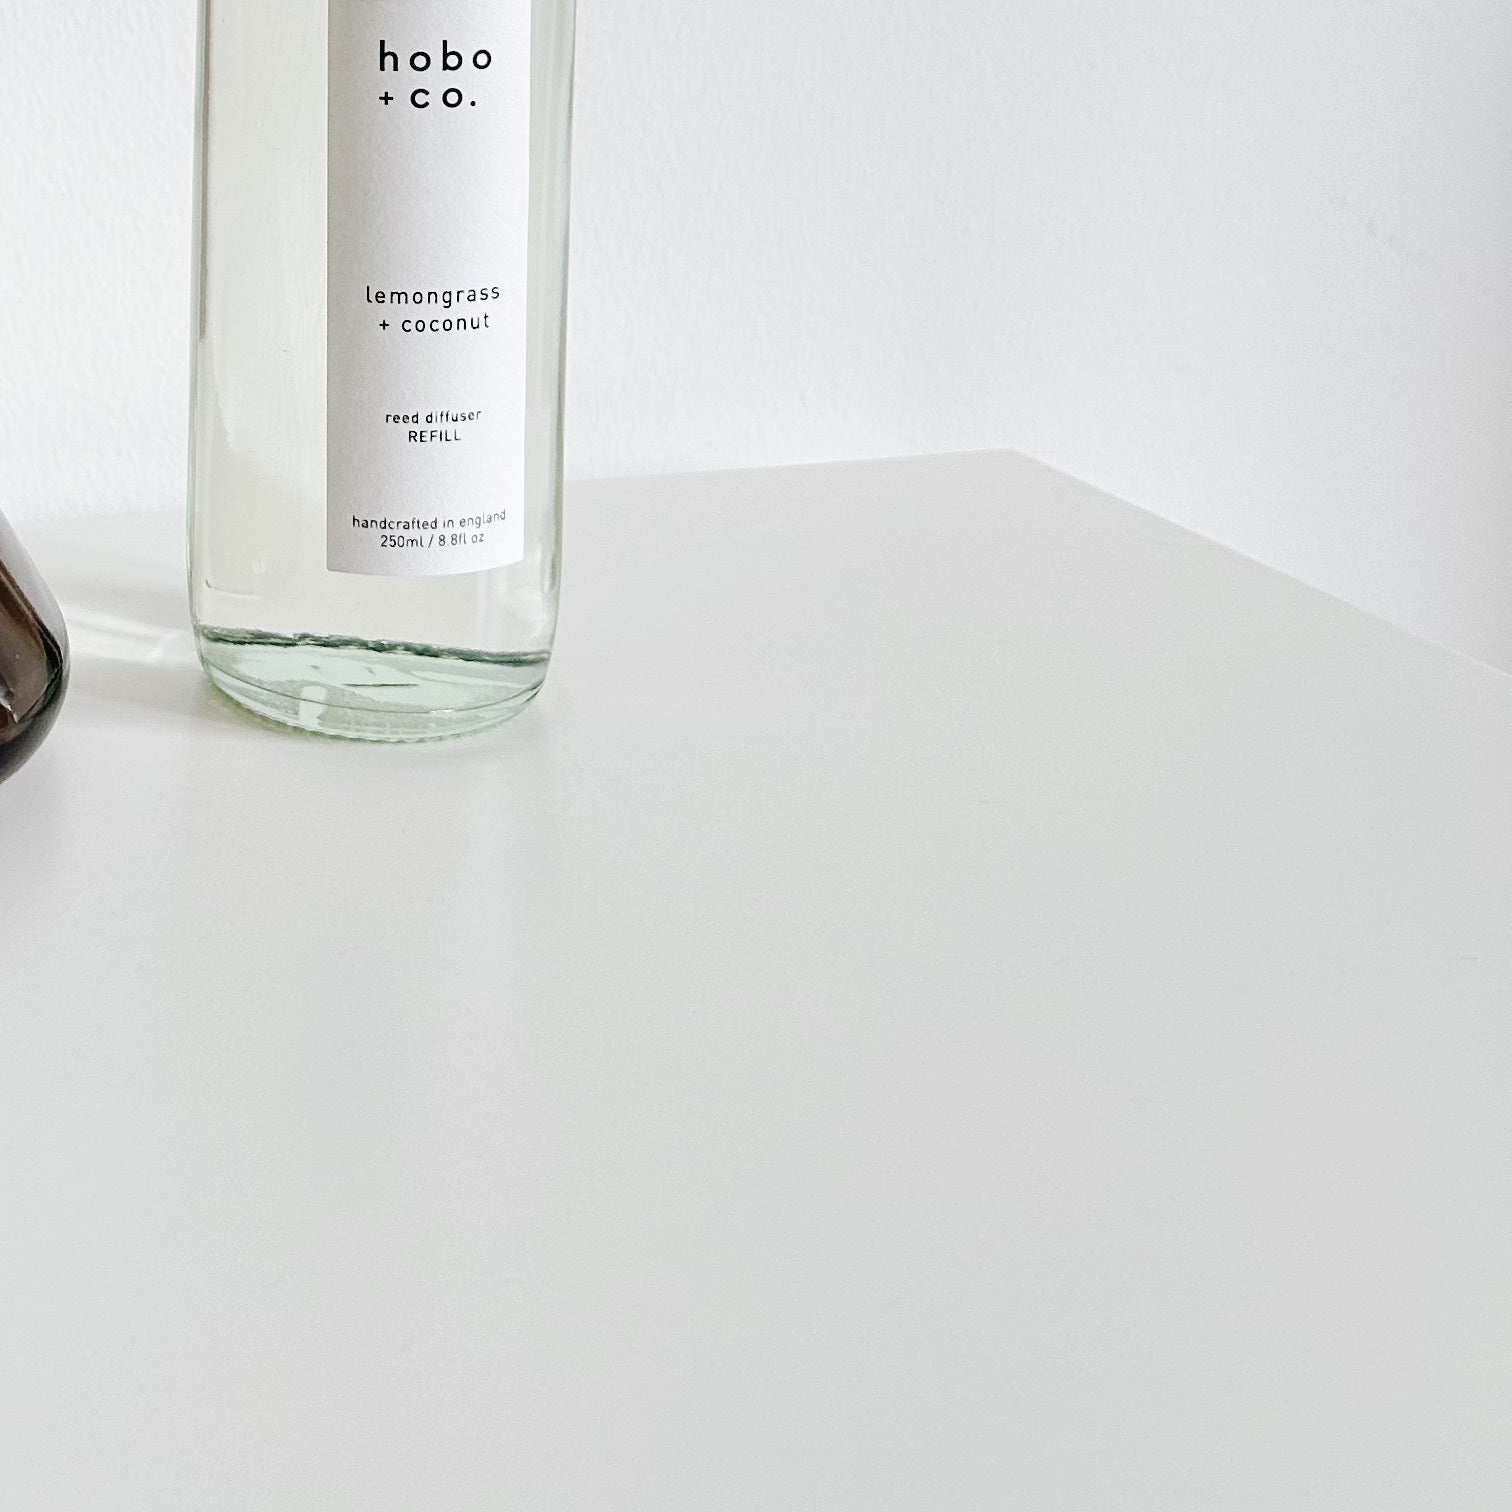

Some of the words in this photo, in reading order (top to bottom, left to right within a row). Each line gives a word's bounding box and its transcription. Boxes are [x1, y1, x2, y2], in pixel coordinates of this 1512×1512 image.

[379, 39, 492, 73] hobo
[379, 90, 396, 106] +
[409, 87, 477, 110] co.
[366, 284, 500, 310] lemongrass
[378, 317, 391, 331] +
[400, 311, 490, 334] coconut
[385, 411, 420, 426] reed
[425, 409, 483, 424] diffuser
[408, 428, 462, 444] REFILL
[352, 513, 438, 531] handcrafted
[442, 517, 455, 529] in
[459, 508, 506, 529] england
[380, 534, 425, 549] 250ml
[471, 533, 485, 545] oz
